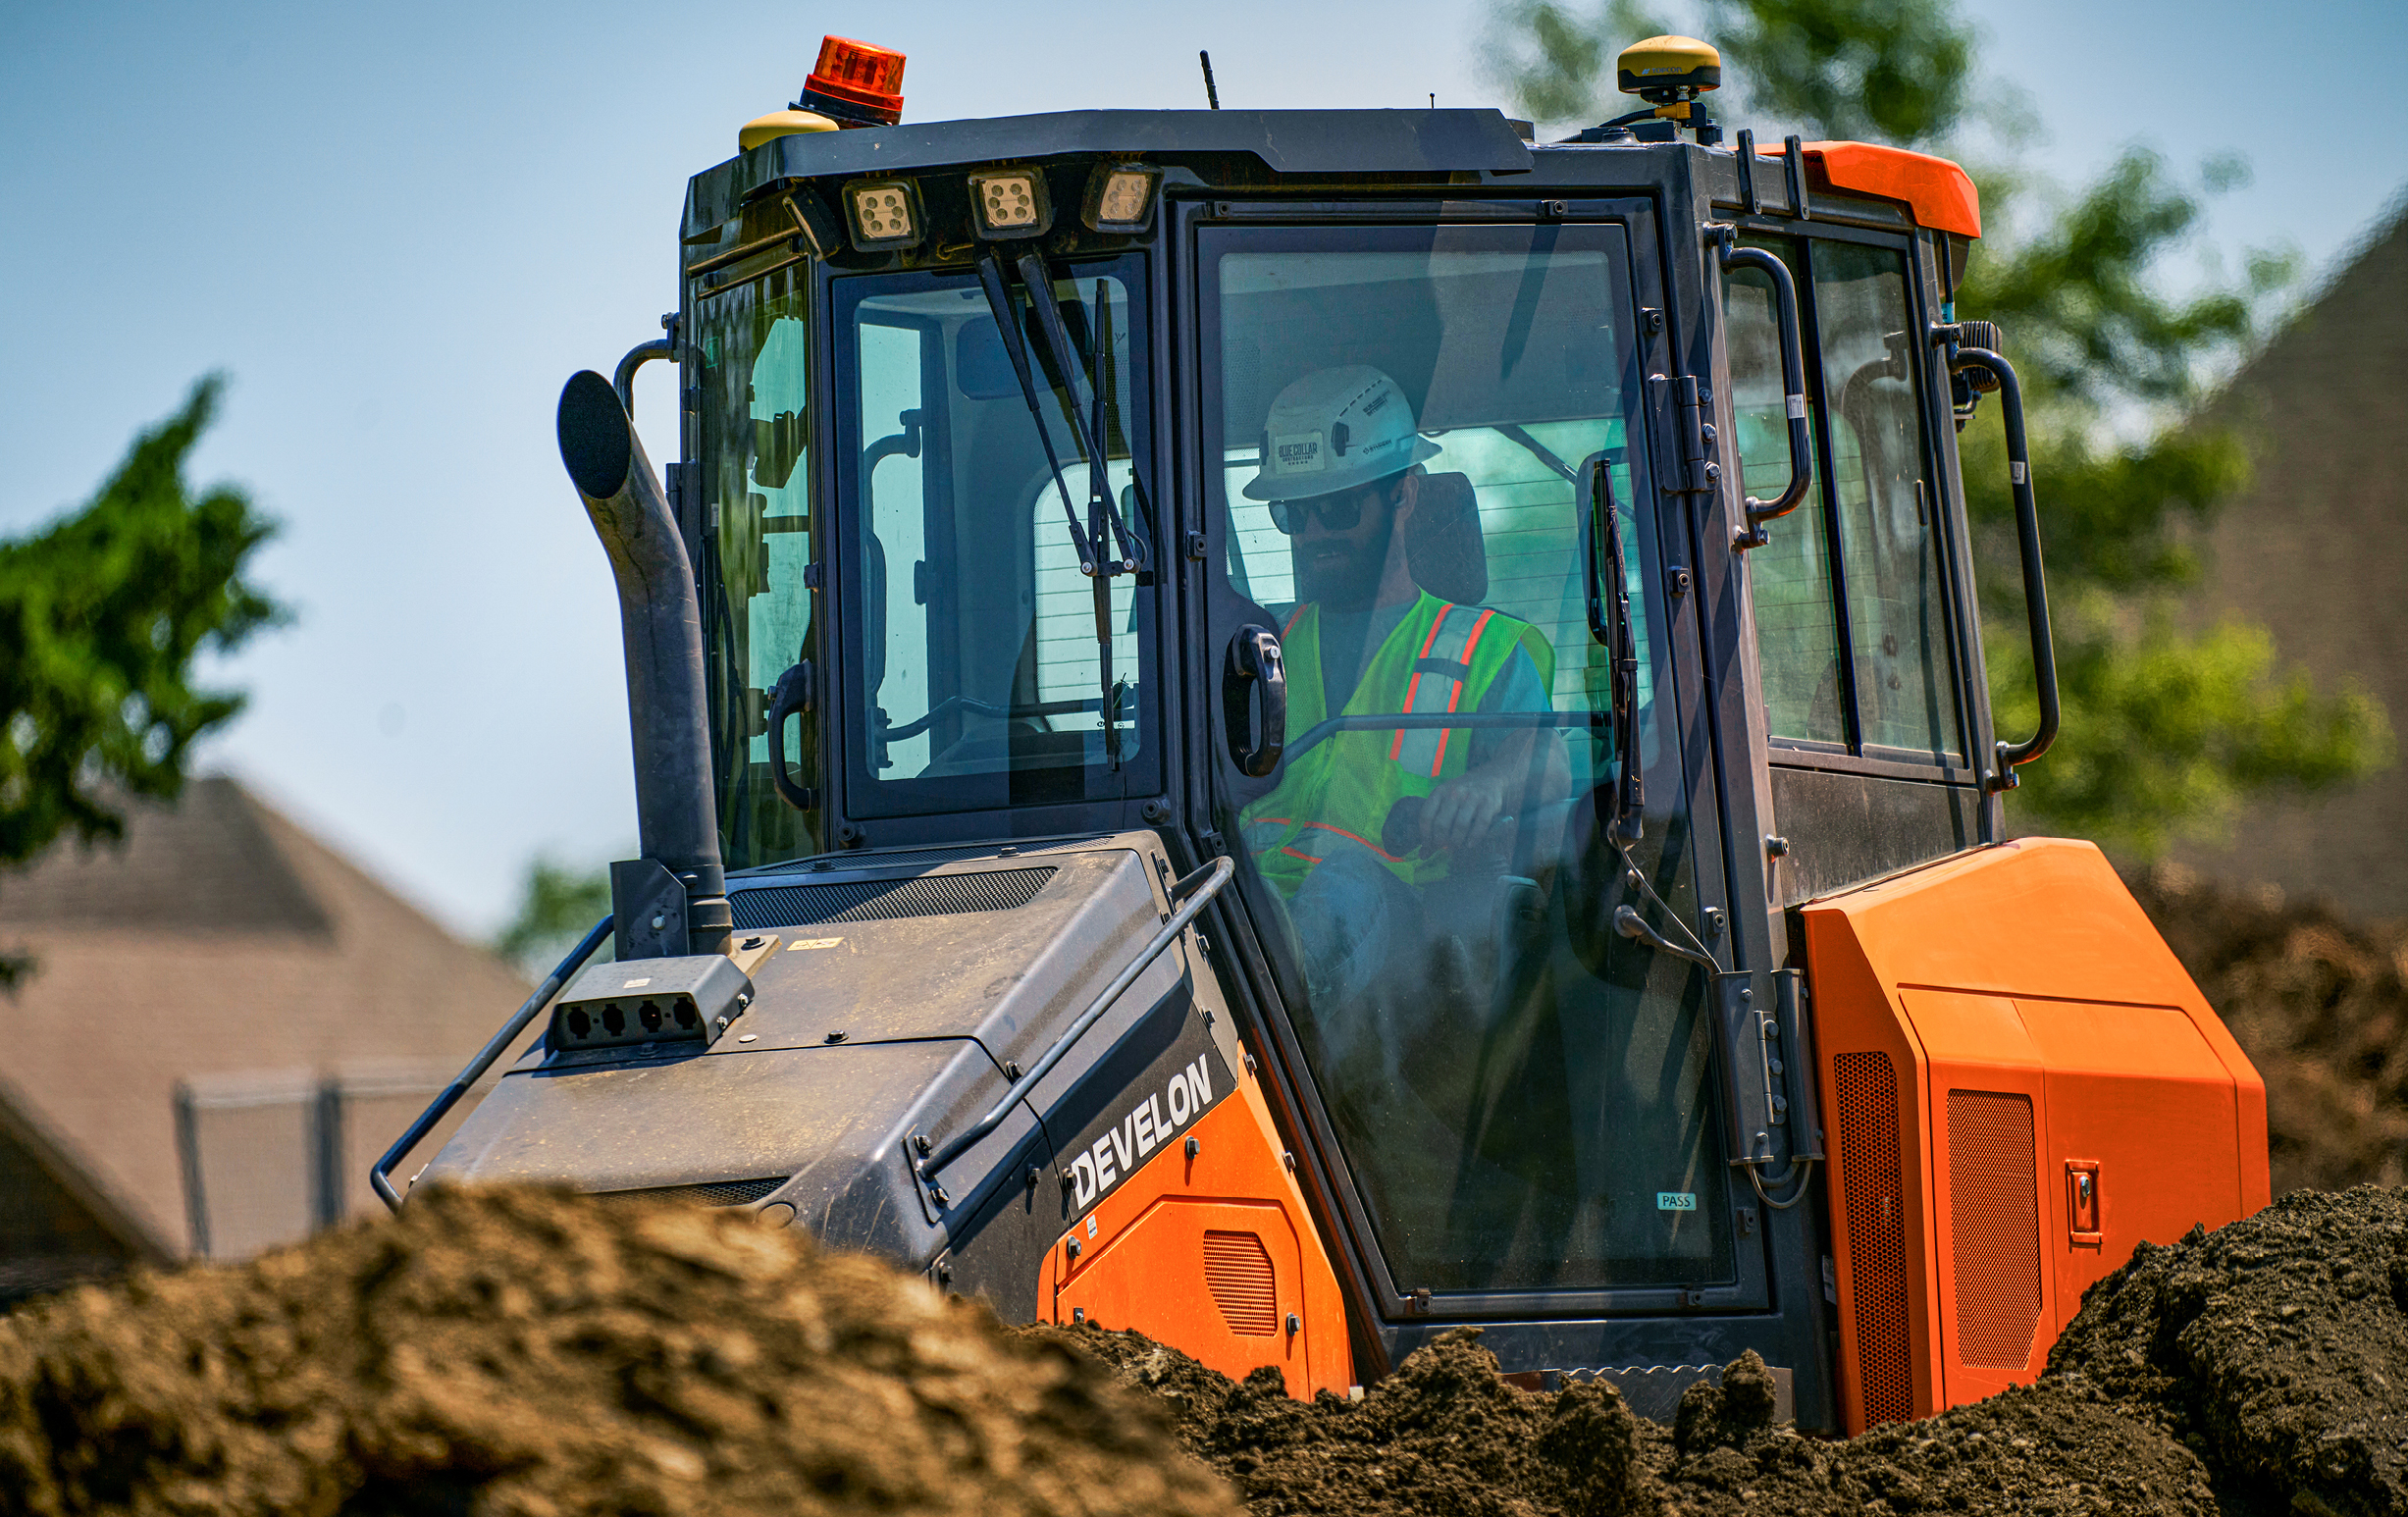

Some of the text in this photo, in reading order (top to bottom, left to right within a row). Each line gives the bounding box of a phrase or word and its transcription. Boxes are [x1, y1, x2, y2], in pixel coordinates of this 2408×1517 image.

[1279, 442, 1318, 457] BLUE COLLAR
[1071, 1053, 1213, 1210] DEVELON
[1662, 1195, 1691, 1207] PASS
